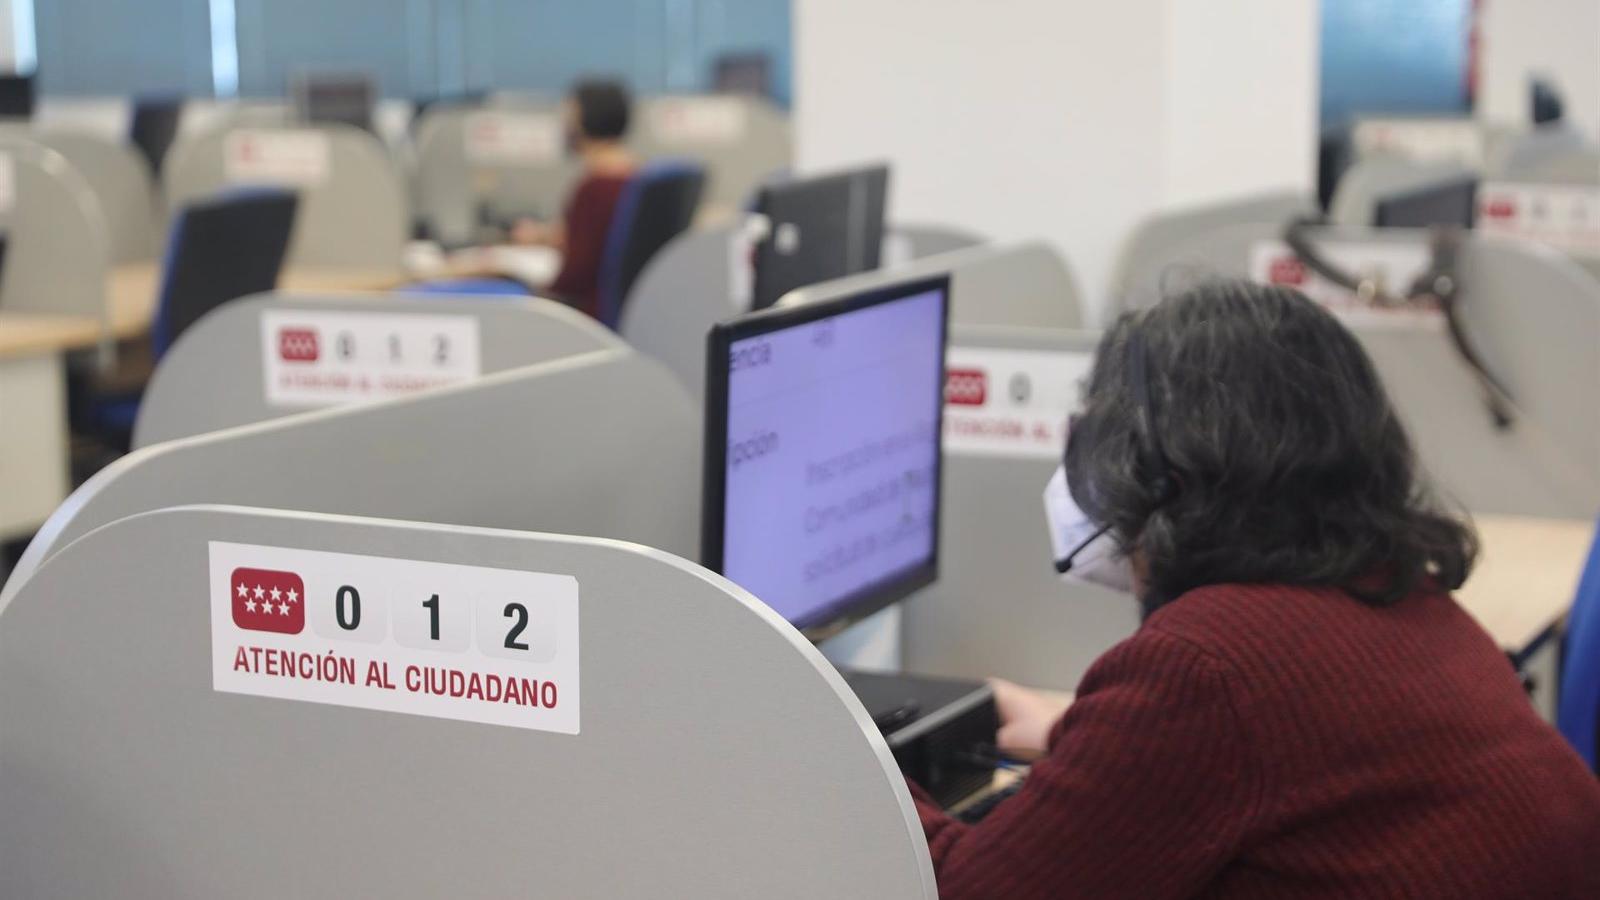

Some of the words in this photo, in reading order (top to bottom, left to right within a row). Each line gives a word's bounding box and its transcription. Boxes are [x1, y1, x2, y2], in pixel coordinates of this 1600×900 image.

[335, 585, 361, 630] 0
[422, 594, 440, 640] 1
[503, 602, 529, 650] 2
[233, 645, 356, 685] ATENCIÓN
[365, 660, 397, 690] AL
[405, 665, 558, 709] CIUDADANO
